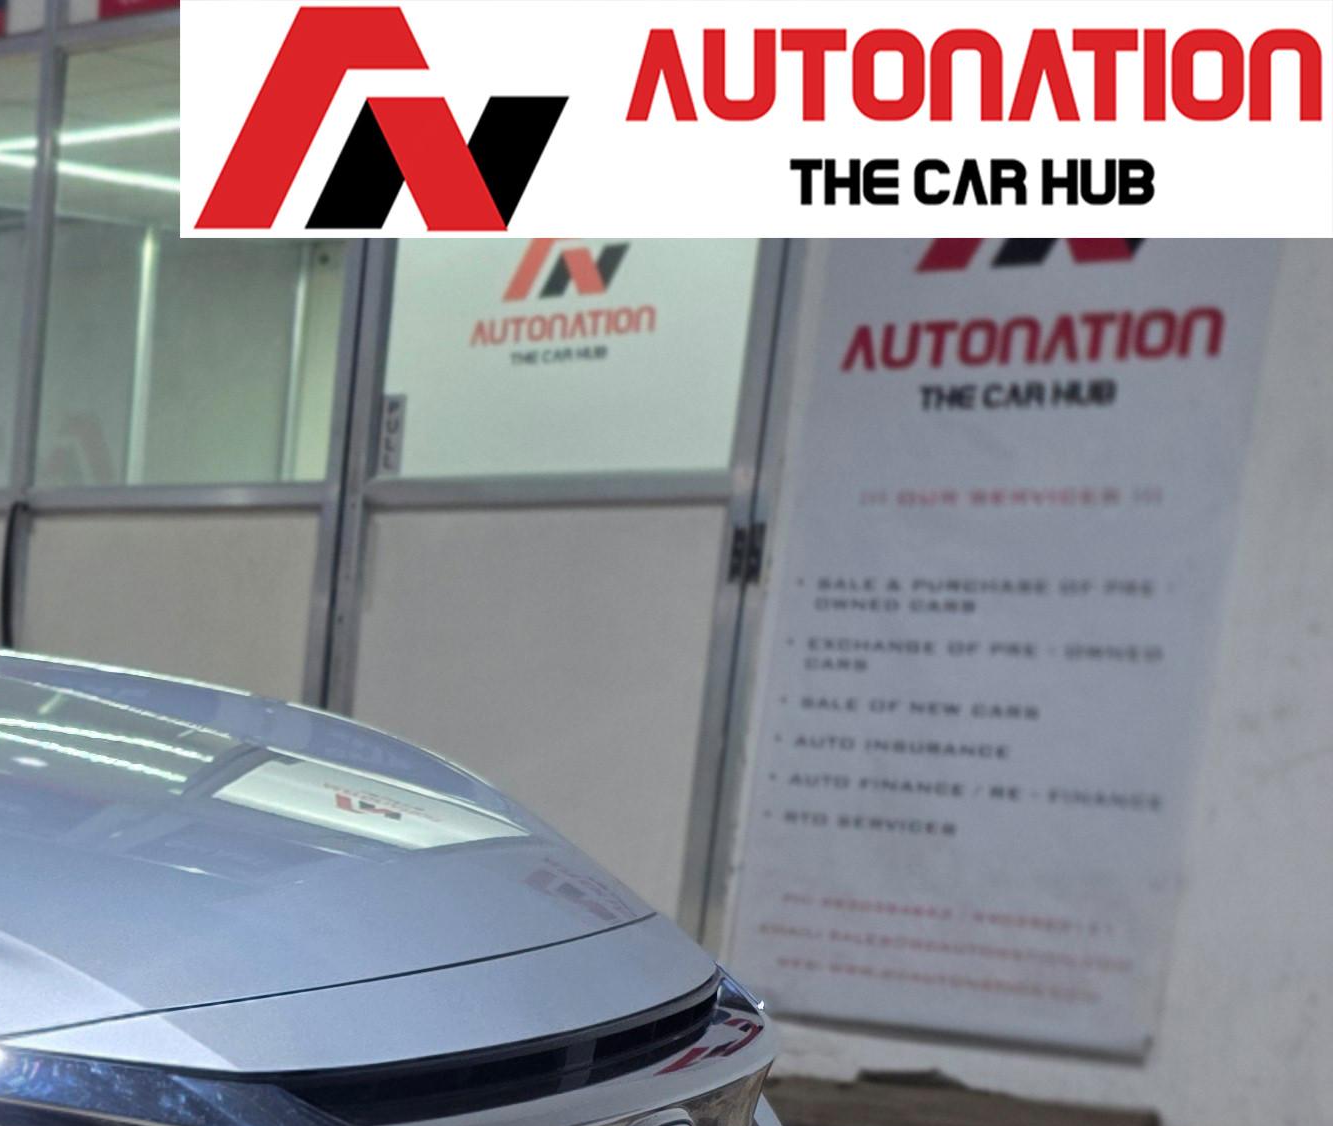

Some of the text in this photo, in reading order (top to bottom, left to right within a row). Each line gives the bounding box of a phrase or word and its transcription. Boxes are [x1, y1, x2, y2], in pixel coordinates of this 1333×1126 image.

[469, 305, 656, 347] AUTONATION
[841, 306, 1225, 372] AUTONATION
[510, 346, 608, 365] THE CAR HUB
[919, 378, 1117, 412] THE CAR HUB
[909, 701, 961, 718] NEW
[794, 734, 856, 752] AUTO
[789, 772, 851, 790] AUTO
[859, 777, 964, 798] FINANCE
